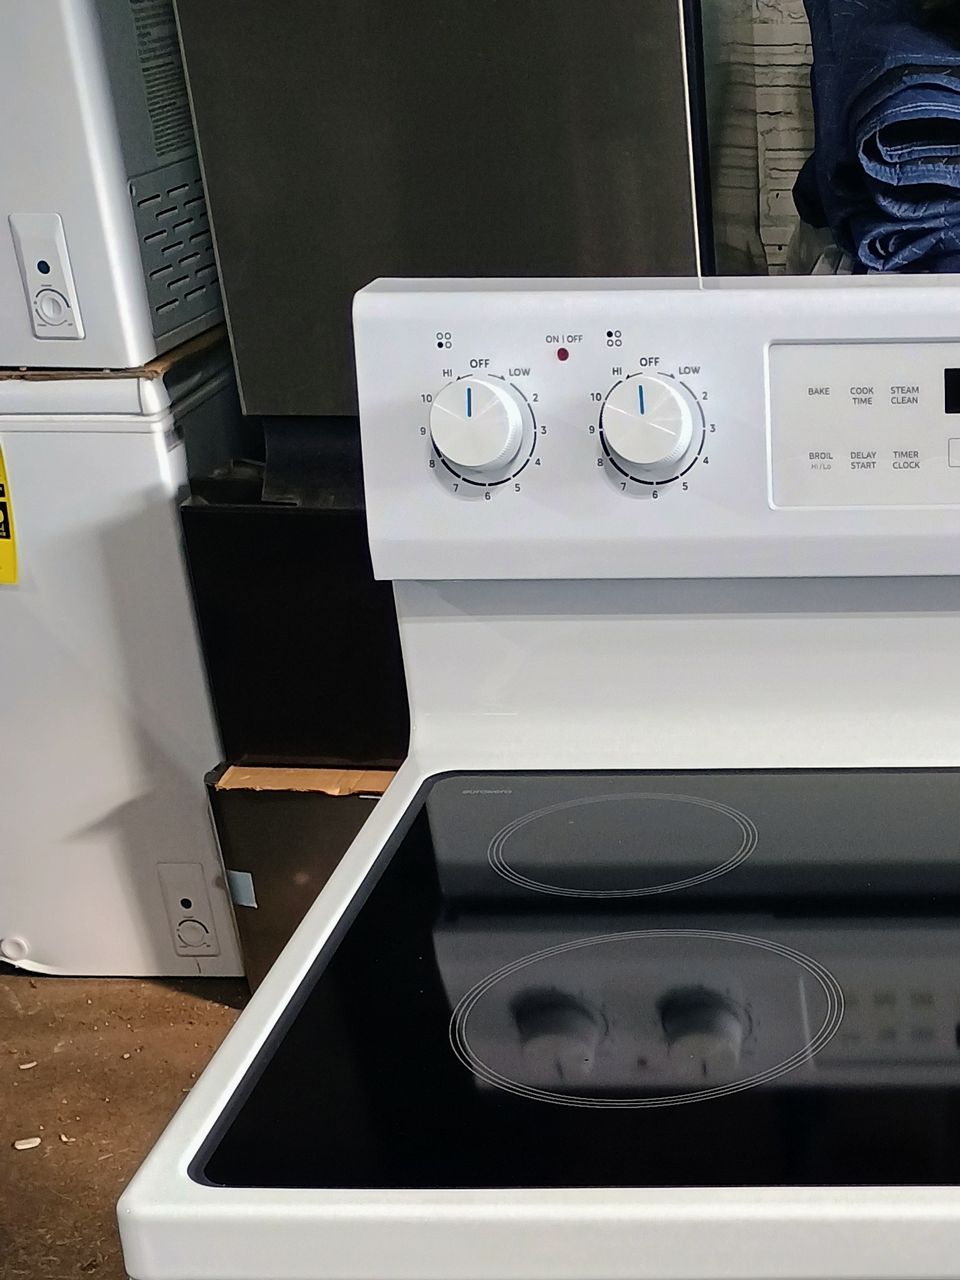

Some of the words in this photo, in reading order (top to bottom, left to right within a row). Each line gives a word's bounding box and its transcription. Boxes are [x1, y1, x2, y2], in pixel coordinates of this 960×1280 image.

[546, 335, 560, 344] ON
[566, 335, 584, 344] OFF
[469, 359, 490, 369] OFF
[640, 357, 660, 367] OFF
[442, 369, 453, 378] HI
[509, 368, 531, 377] LOW
[612, 367, 622, 376] HI
[678, 366, 701, 376] LOW
[808, 388, 831, 396] BAKE
[850, 387, 874, 396] COOK
[890, 387, 920, 395] STEAM
[421, 394, 433, 404] 10
[532, 393, 539, 403] 2
[590, 393, 602, 402] 10
[702, 392, 709, 401] 2
[852, 397, 873, 405] TIME
[890, 396, 919, 405] CLEAN
[420, 426, 427, 436] 9
[540, 426, 547, 436] 3
[589, 425, 596, 435] 9
[710, 424, 716, 434] 3
[809, 452, 833, 460] BROIL
[850, 451, 877, 460] DELAY
[893, 451, 919, 460] TIMER
[429, 459, 436, 469] 8
[535, 458, 542, 467] 4
[597, 458, 604, 468] 8
[703, 456, 710, 465] 4
[892, 461, 921, 469] CLOCK
[850, 461, 877, 470] START
[453, 483, 459, 494] 7
[515, 484, 521, 493] 5
[620, 482, 627, 492] 7
[682, 482, 688, 492] 5
[484, 492, 492, 502] 6
[652, 490, 659, 500] 6
